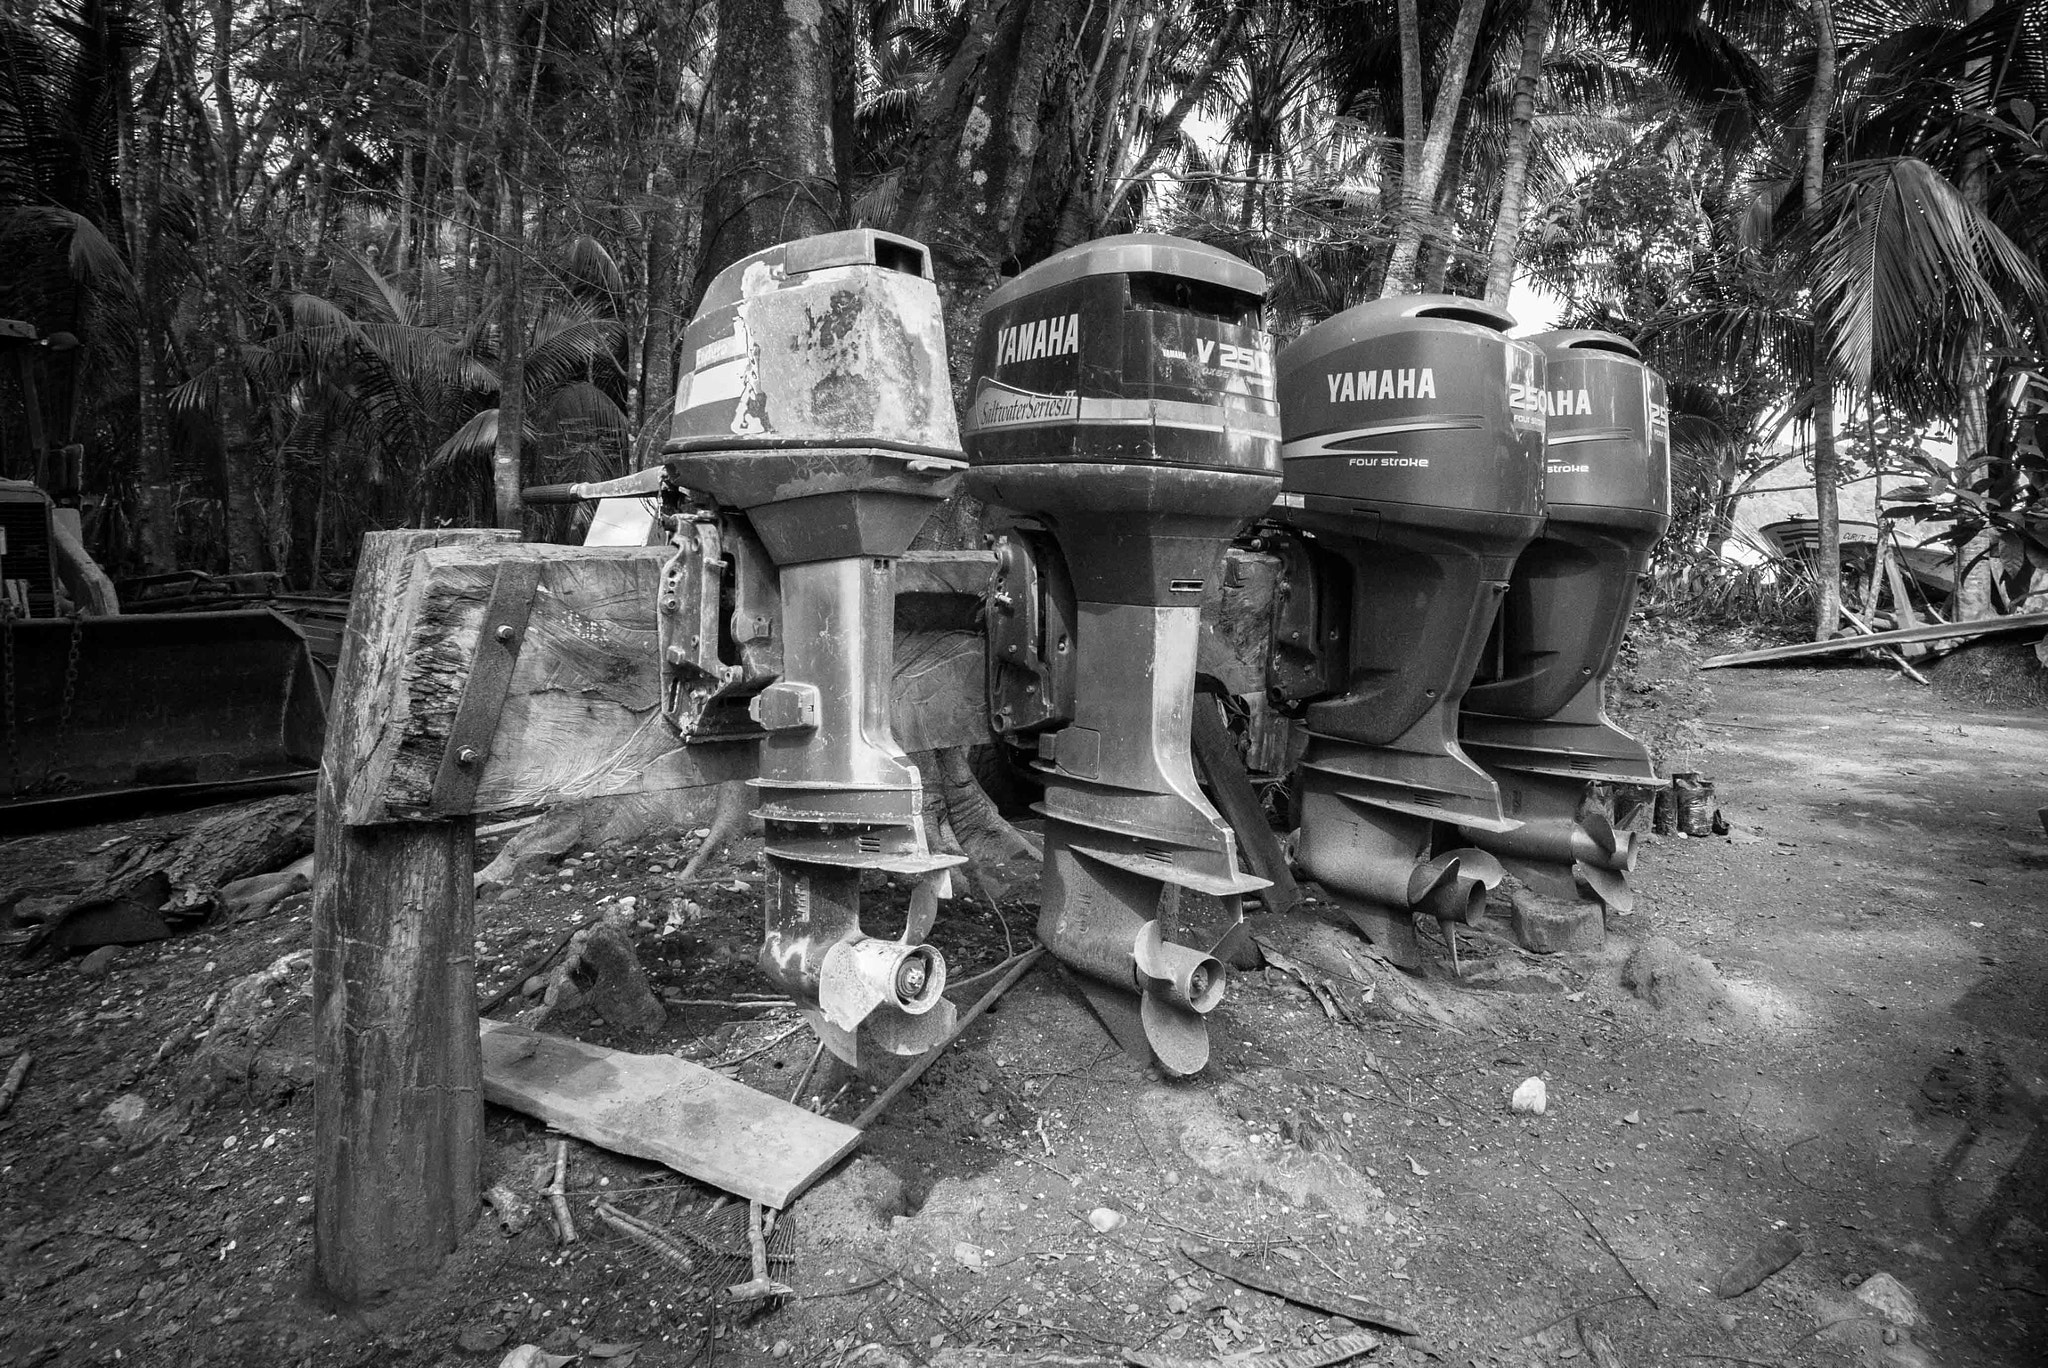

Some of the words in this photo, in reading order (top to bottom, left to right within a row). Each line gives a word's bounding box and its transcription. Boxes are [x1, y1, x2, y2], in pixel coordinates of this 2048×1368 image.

[998, 313, 1079, 366] YAMAHA
[1327, 368, 1437, 403] YAMAHA
[1509, 383, 1547, 415] 250
